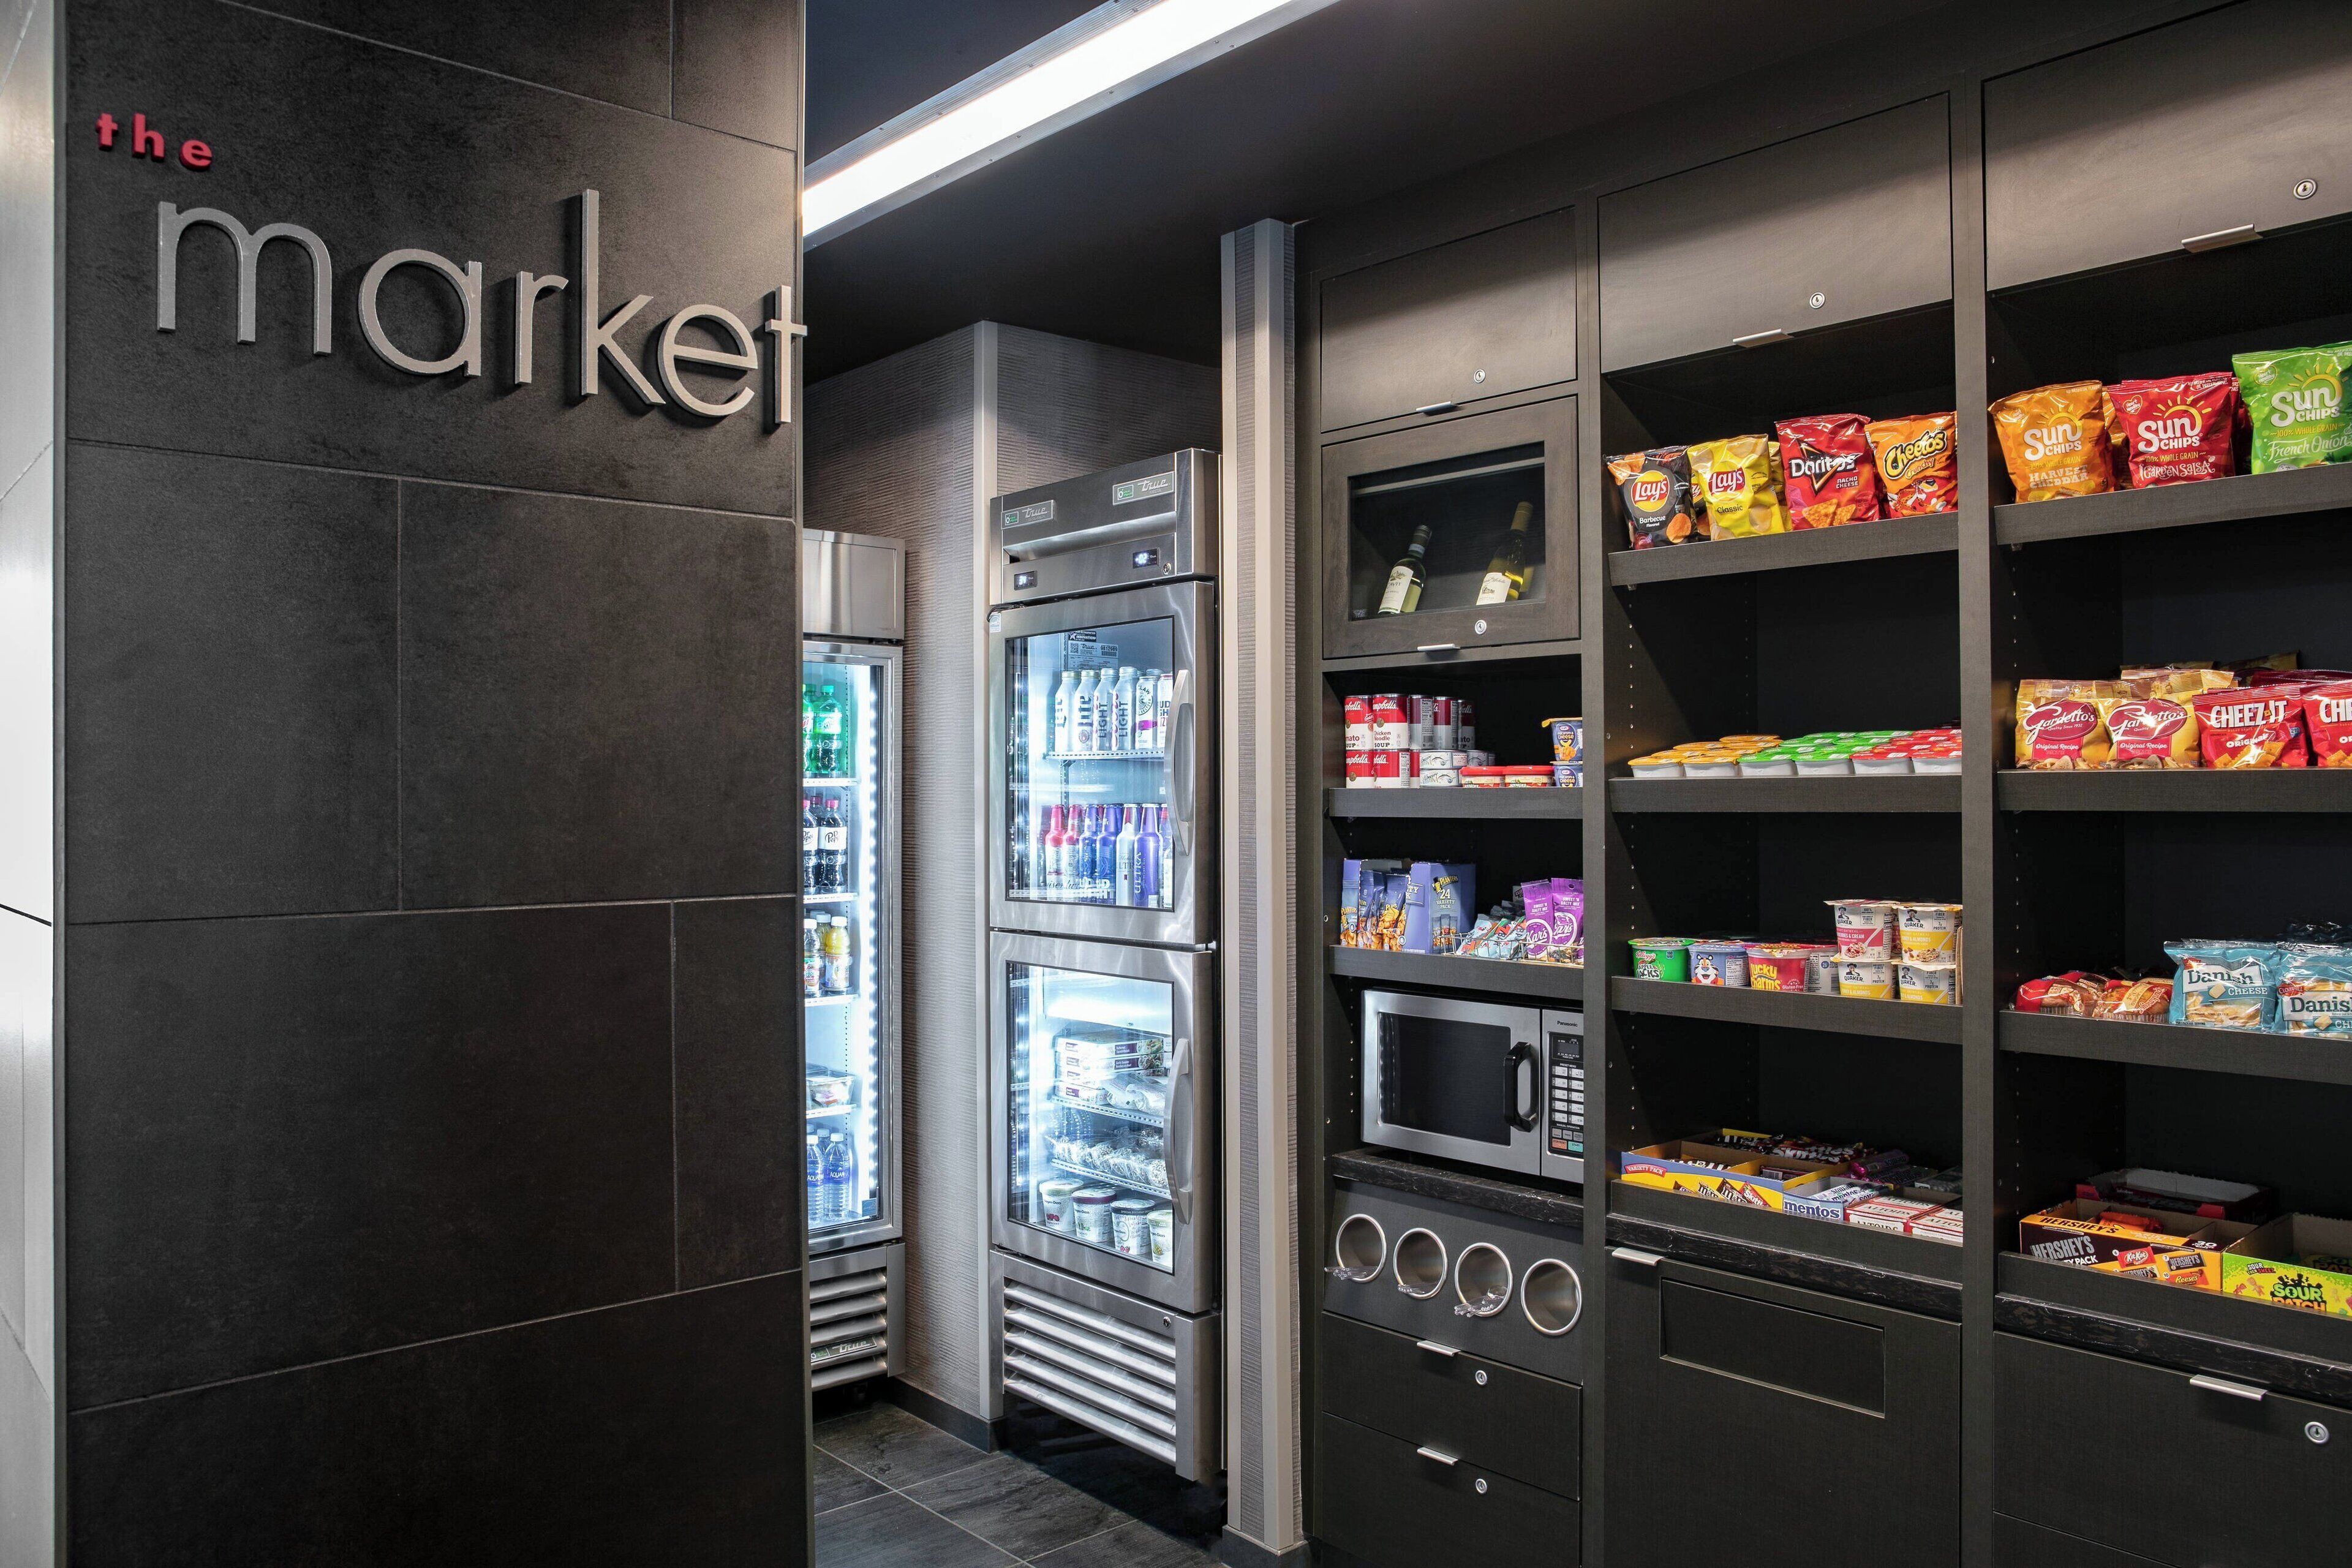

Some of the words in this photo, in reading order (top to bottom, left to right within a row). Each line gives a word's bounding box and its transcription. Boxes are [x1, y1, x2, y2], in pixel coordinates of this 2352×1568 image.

[95, 112, 213, 171] the
[157, 189, 808, 424] market
[2271, 386, 2342, 428] Sun
[2296, 407, 2340, 422] CHIPS
[2138, 418, 2201, 453] Sun
[2295, 426, 2316, 435] WHOLE
[2317, 424, 2337, 432] GRAIN
[2024, 423, 2082, 461] Sun
[2045, 440, 2082, 456] CHIPS
[2162, 435, 2201, 450] CHIPS
[2268, 437, 2310, 461] French
[2312, 434, 2348, 452] Onion
[1885, 429, 1947, 478] Cheetos
[2045, 459, 2062, 467] WHOLE
[2063, 456, 2081, 466] GRAIN
[2180, 451, 2199, 460] GRAIN
[1791, 454, 1856, 477] Doritos
[1905, 458, 1935, 479] Crunchy
[2029, 464, 2088, 481] HARVEST
[1712, 468, 1743, 494] Lay's
[1836, 480, 1859, 489] CHEESE
[1837, 476, 1858, 484] NACHO
[2029, 473, 2089, 489] CHEDDAR
[1634, 480, 1668, 502] Lay's
[1717, 504, 1743, 514] Classic
[1639, 515, 1666, 524] Barbecue
[1118, 701, 1128, 737] LIGHT
[2023, 706, 2095, 745] Gardetto's
[1439, 876, 1458, 886] PLANTERS
[1439, 889, 1451, 899] 24
[1635, 951, 1656, 960] Kellogg's
[2187, 970, 2254, 985] Danish
[2228, 987, 2267, 996] CHEESE
[1649, 1167, 1664, 1175] PACK
[1784, 1200, 1840, 1219] mentos
[2040, 1216, 2120, 1234] HERSHEY'S
[2032, 1235, 2095, 1260] HERSHEY'S
[2170, 1255, 2201, 1267] HERSHEY'S
[2273, 1283, 2322, 1302] SOUR
